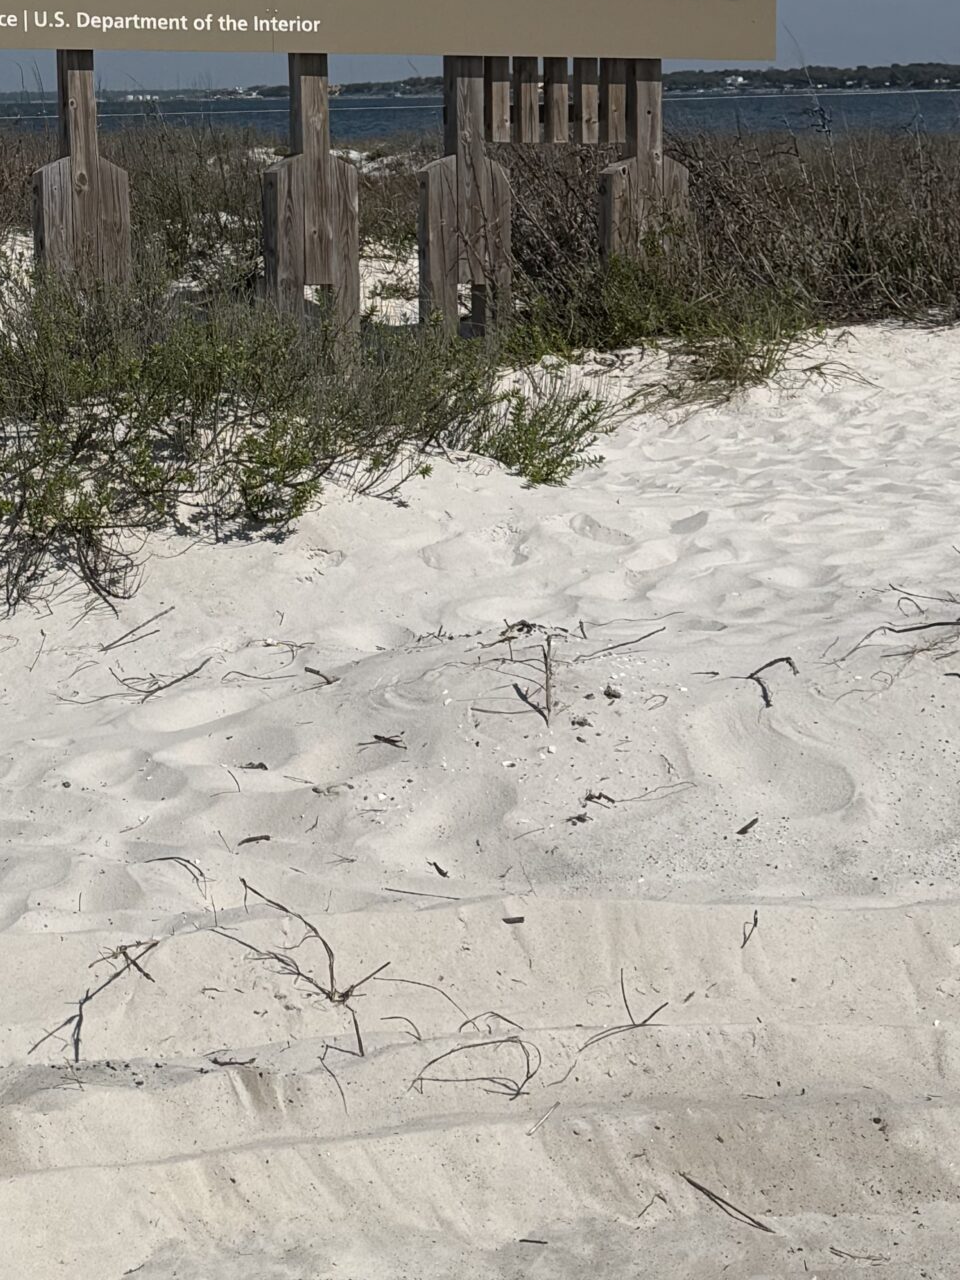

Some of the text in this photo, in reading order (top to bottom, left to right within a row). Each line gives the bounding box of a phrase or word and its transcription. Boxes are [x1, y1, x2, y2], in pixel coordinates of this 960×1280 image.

[34, 11, 70, 28] U.S.
[76, 12, 188, 32] Department
[193, 13, 213, 31] of
[217, 14, 248, 32] the
[253, 15, 321, 32] Interior
